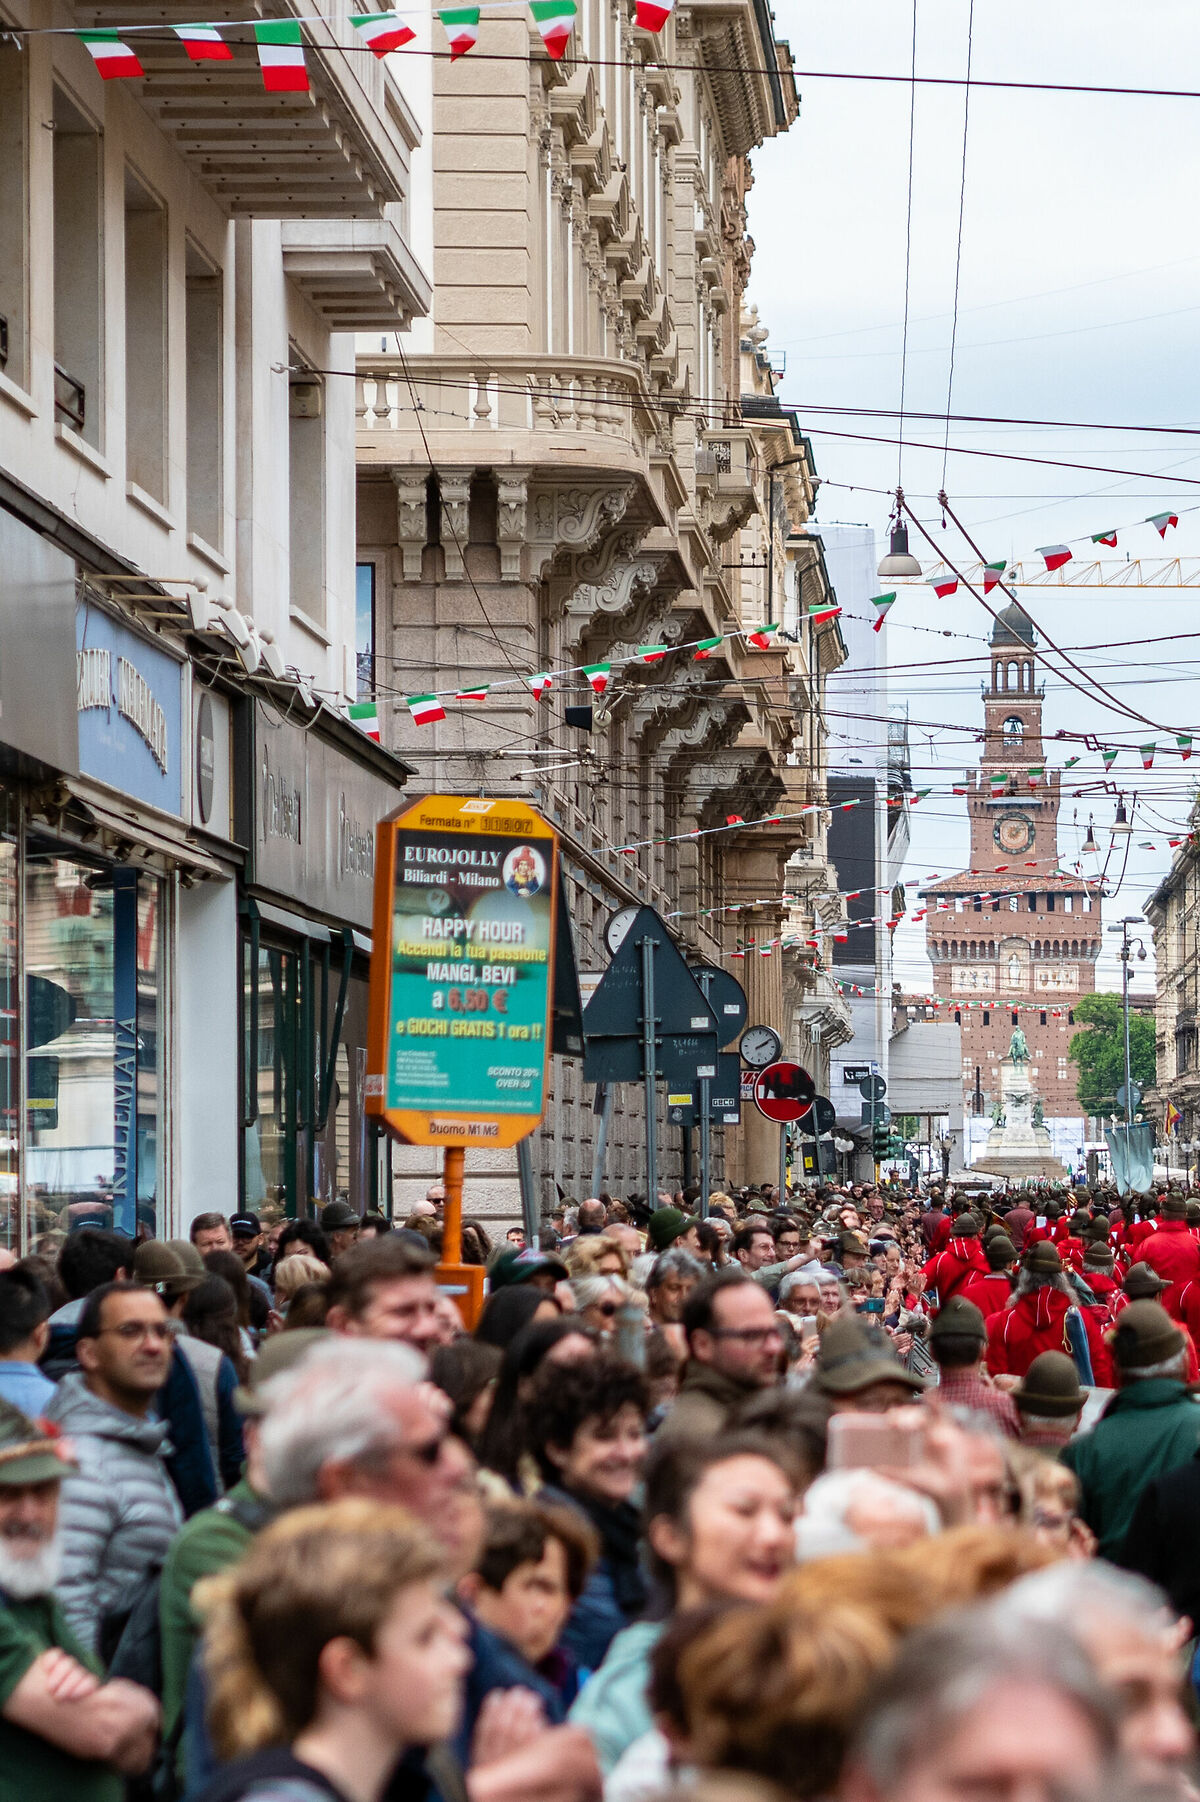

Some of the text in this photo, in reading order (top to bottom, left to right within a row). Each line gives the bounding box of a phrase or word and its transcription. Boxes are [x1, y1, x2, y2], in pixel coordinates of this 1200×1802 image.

[420, 814, 532, 833] Fermata n° 11507
[404, 846, 501, 867] EUROJOLLY
[403, 868, 447, 885] Biliardi
[458, 872, 500, 887] Milano
[422, 917, 525, 942] HAPPY HOUR
[397, 940, 548, 962] Accendi la tua passione
[426, 962, 517, 986] MANGI, BEVI
[431, 990, 444, 1009] a
[492, 989, 509, 1014] €
[396, 1020, 405, 1034] e
[407, 1018, 448, 1036] GIOCHI
[451, 1020, 495, 1038] GRATIS
[499, 1023, 506, 1038] 1
[508, 1025, 530, 1040] ora
[487, 1066, 522, 1078] SCONTO
[496, 1079, 519, 1089] OVER
[113, 1016, 137, 1197] KELEMATA
[430, 1121, 498, 1137] Duomo M1 M3
